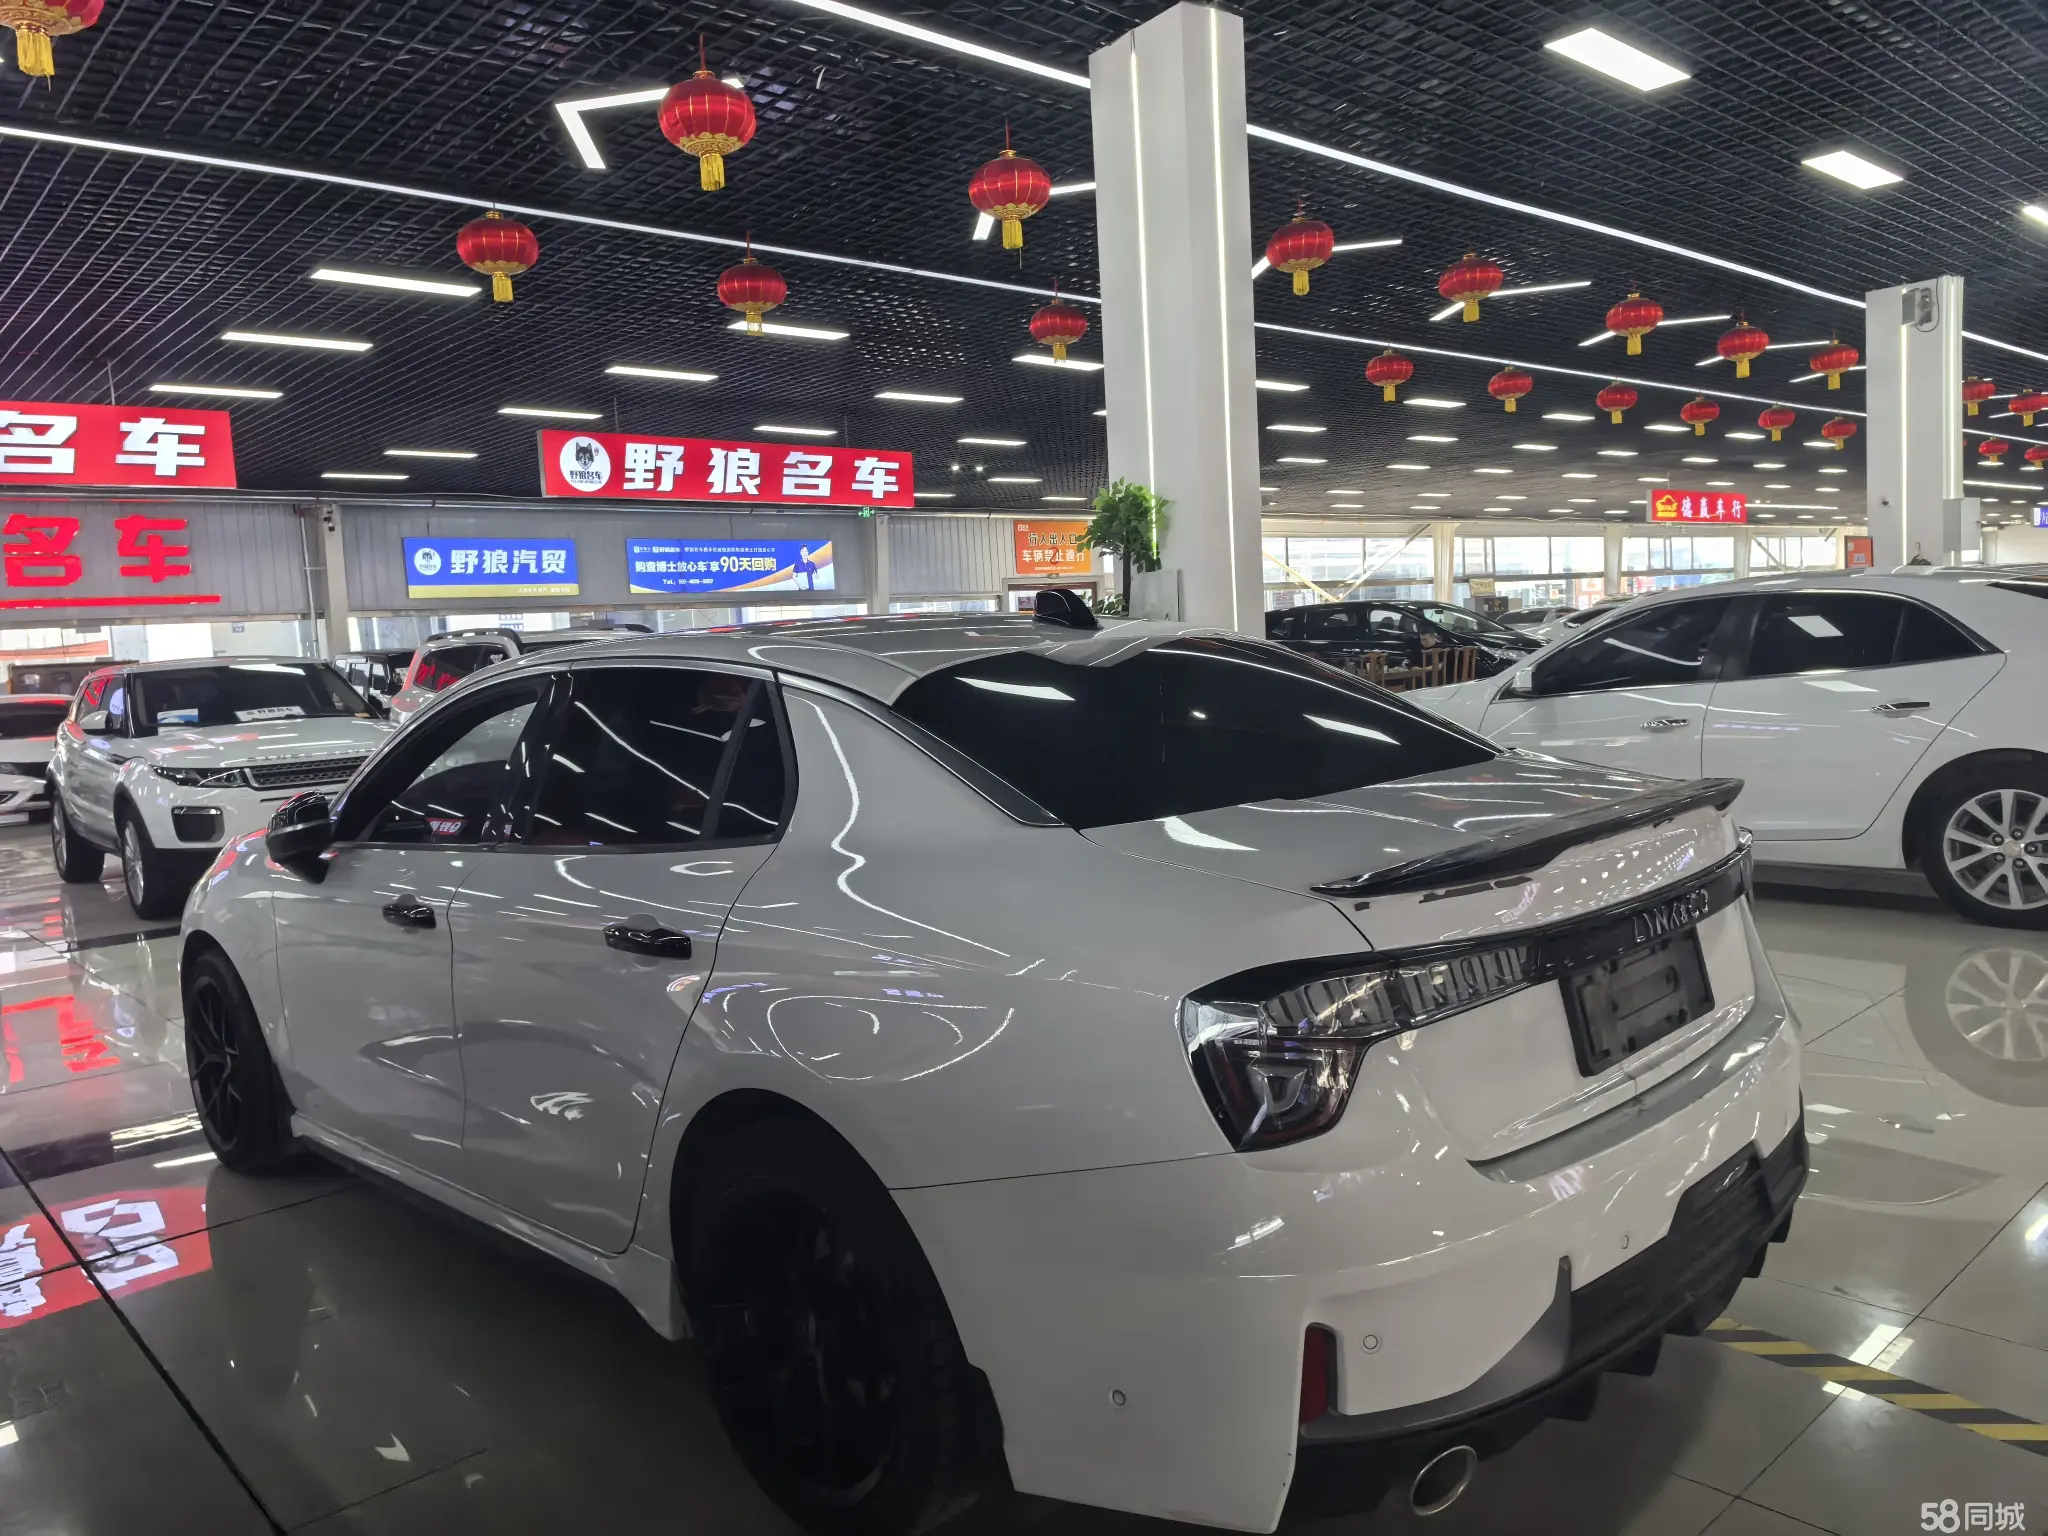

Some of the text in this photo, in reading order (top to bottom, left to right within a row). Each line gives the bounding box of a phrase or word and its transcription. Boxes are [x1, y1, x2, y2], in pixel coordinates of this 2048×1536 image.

[0, 410, 206, 476] 名车
[623, 443, 900, 499] 野狼名车
[3, 513, 192, 587] 名车
[450, 549, 567, 574] 野狼汽贸
